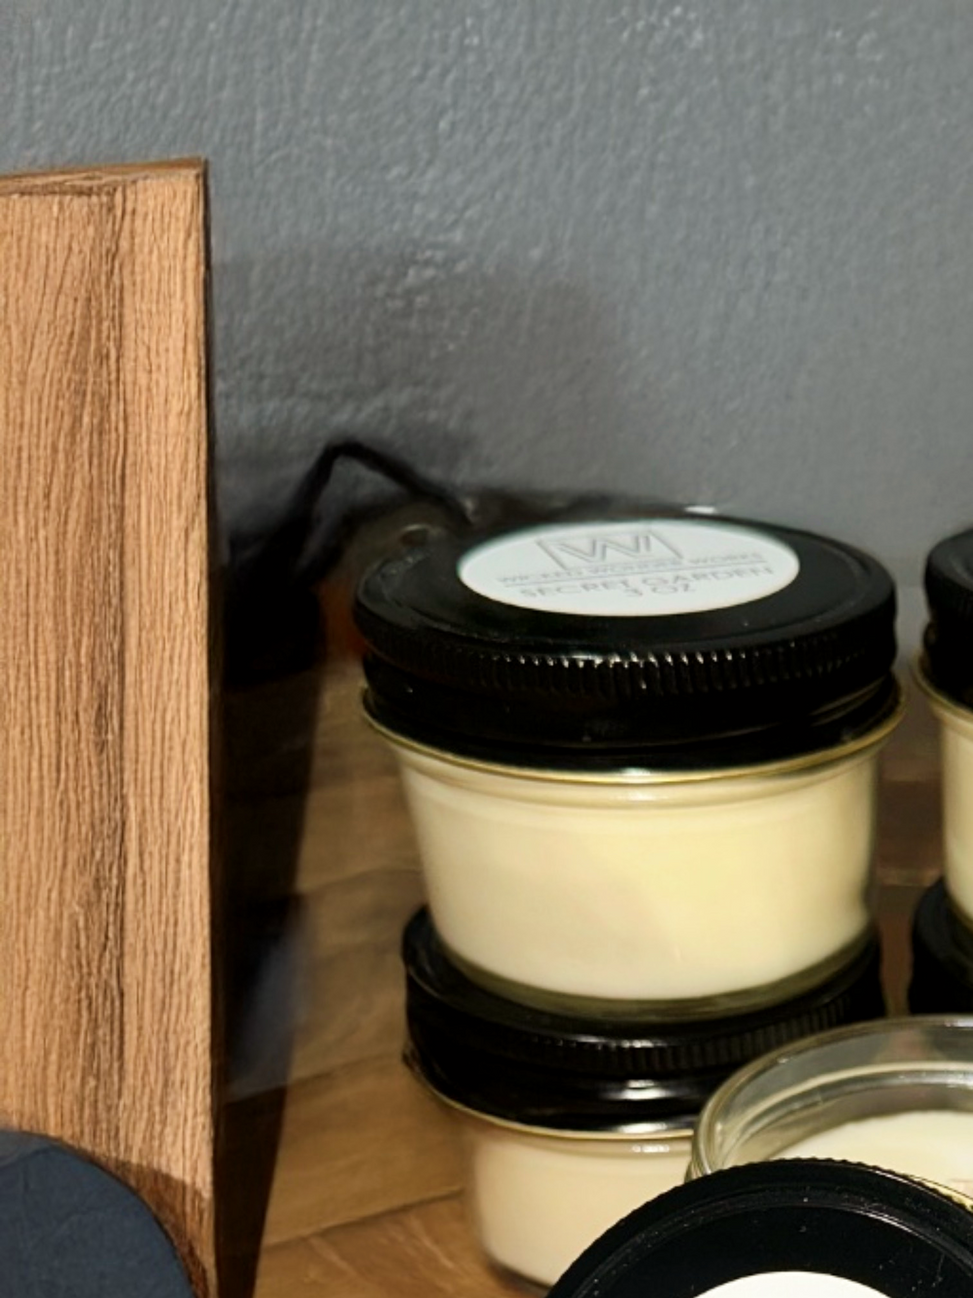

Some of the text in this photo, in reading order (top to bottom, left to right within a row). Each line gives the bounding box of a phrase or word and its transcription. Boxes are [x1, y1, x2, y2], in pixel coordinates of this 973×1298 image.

[520, 566, 774, 597] SECRET GARDEN
[650, 581, 696, 595] OZ
